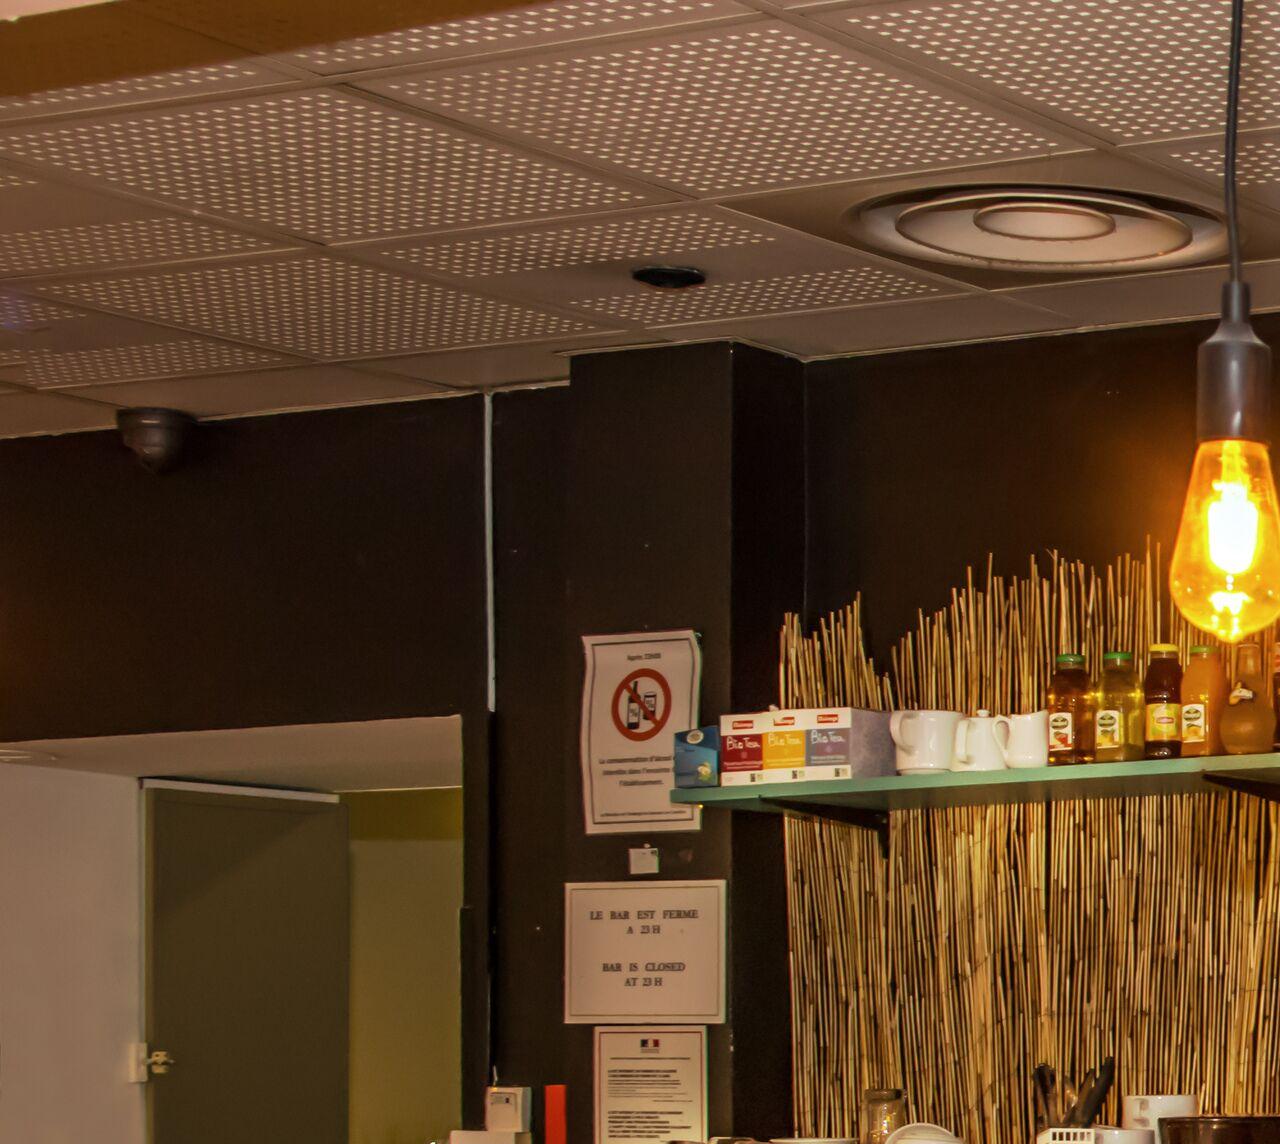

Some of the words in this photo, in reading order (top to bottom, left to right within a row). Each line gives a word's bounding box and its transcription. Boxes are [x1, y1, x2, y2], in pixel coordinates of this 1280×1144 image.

[590, 911, 603, 920] LE
[610, 910, 630, 920] BAR
[637, 910, 656, 920] EST
[663, 909, 698, 919] FERME
[602, 963, 622, 972] BAR
[629, 963, 638, 972] IS
[645, 962, 686, 972] CLOSED
[624, 978, 638, 986] AT
